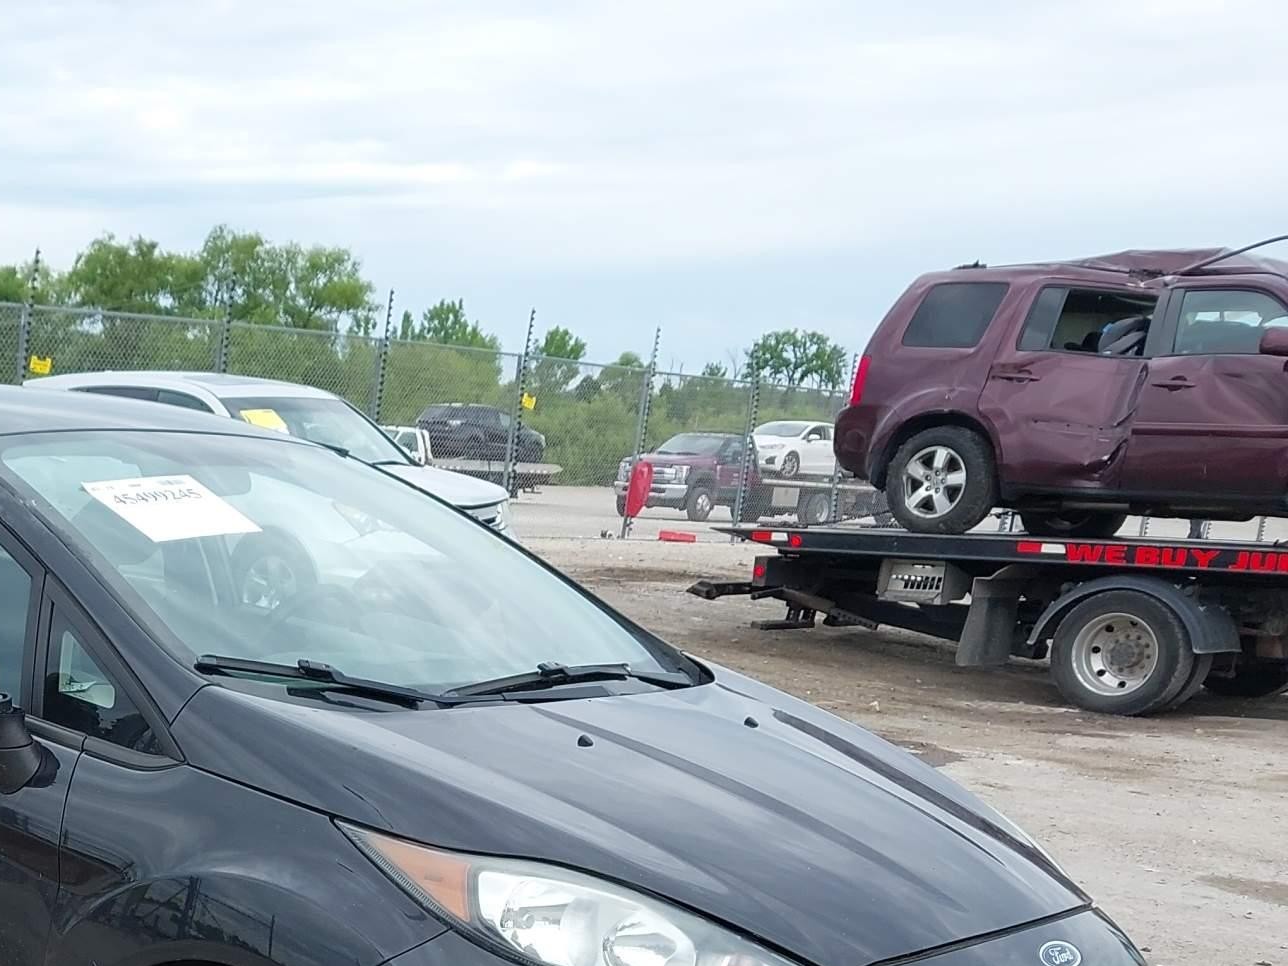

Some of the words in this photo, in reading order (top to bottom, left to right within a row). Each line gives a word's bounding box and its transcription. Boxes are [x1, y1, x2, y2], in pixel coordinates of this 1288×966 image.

[1066, 543, 1128, 565] WE
[1134, 546, 1221, 569] BUY
[1048, 946, 1074, 965] Ford
